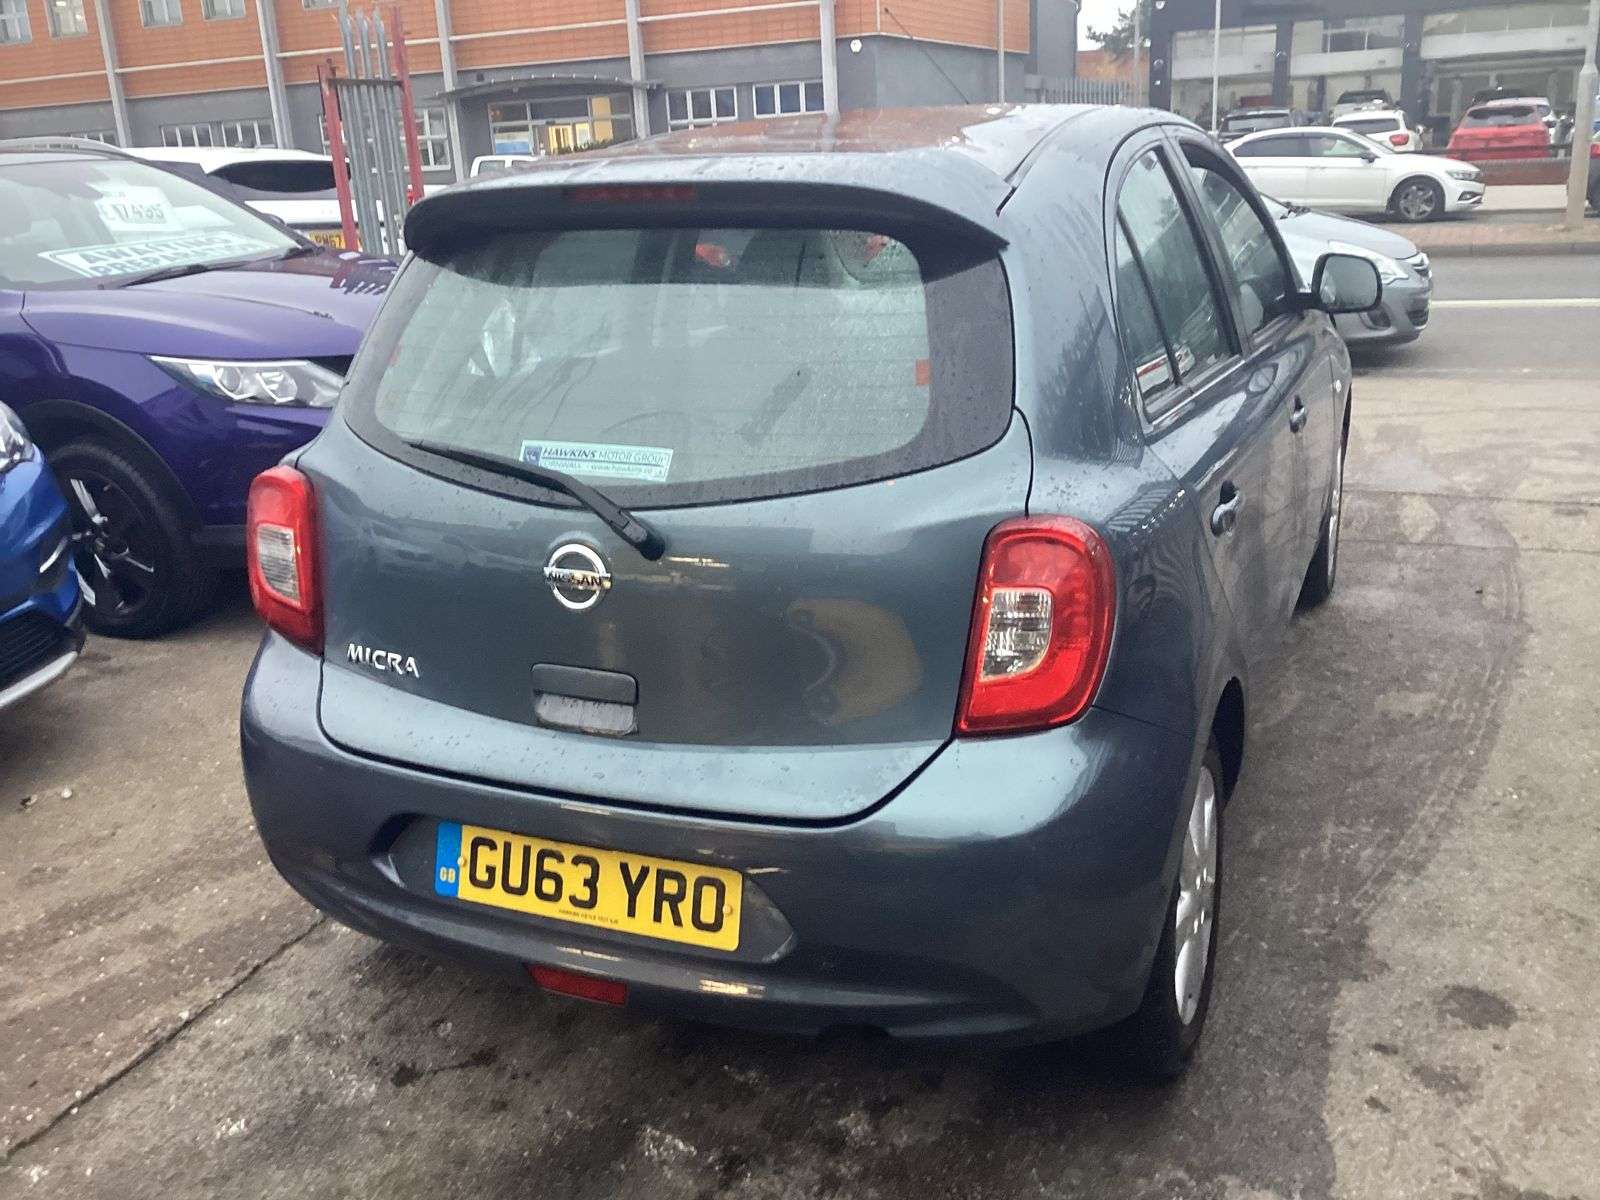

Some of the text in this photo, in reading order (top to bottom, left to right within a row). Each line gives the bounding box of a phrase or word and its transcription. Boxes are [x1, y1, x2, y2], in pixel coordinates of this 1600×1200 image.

[542, 447, 597, 459] HAWKINS
[598, 449, 633, 462] MOTOR
[347, 643, 420, 678] MICRA
[440, 866, 456, 884] GB
[468, 836, 726, 933] GU63 YRO
